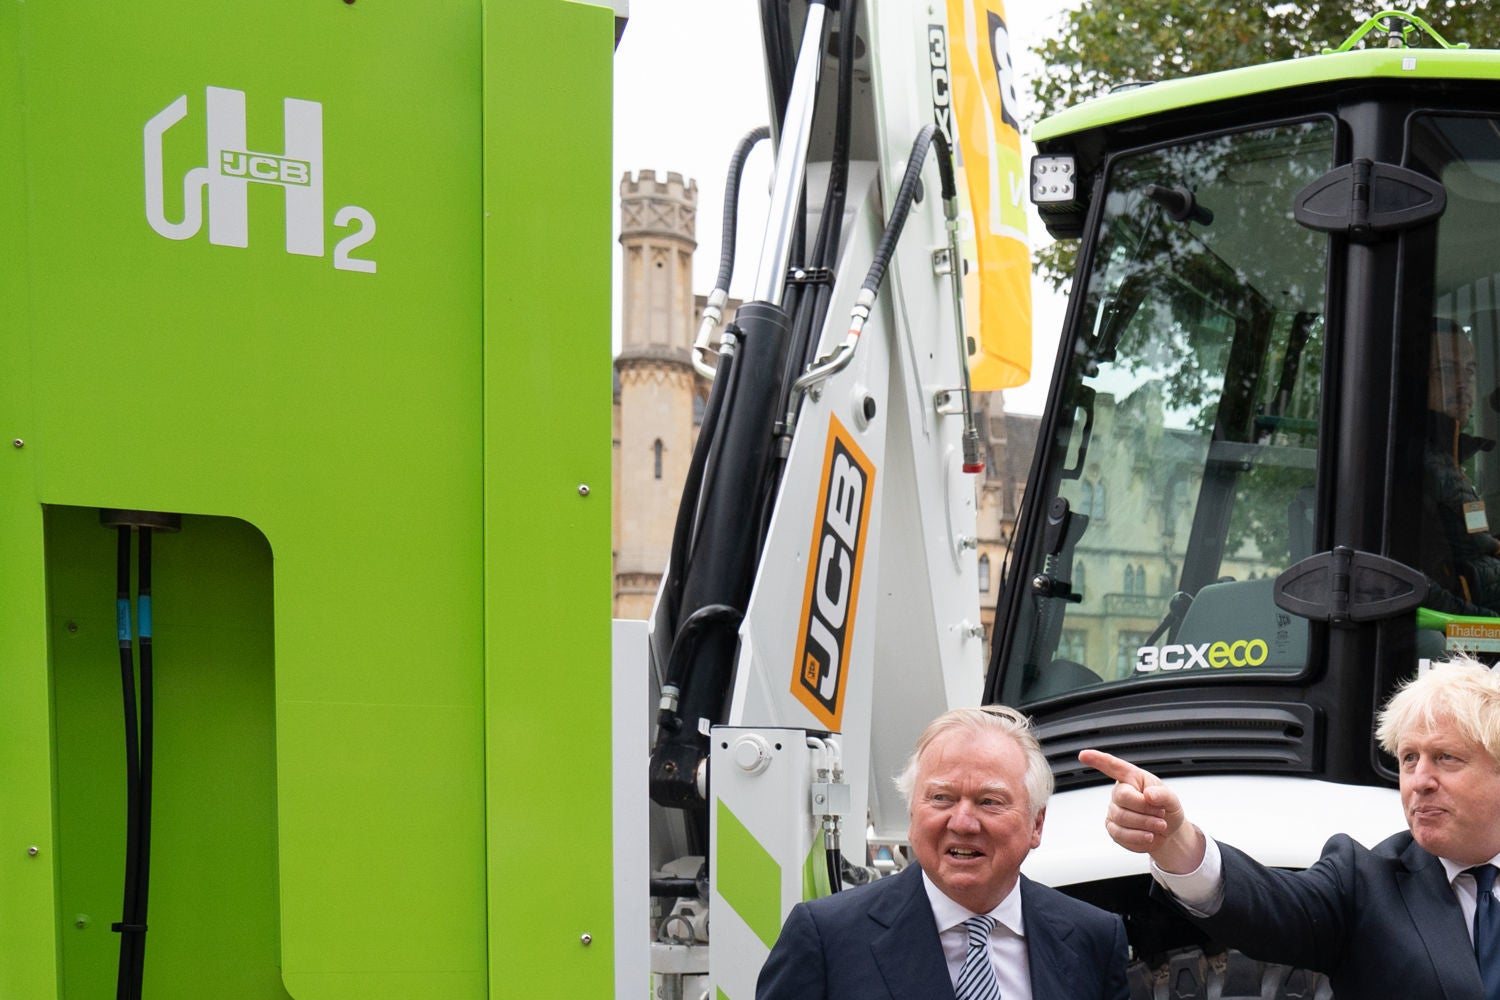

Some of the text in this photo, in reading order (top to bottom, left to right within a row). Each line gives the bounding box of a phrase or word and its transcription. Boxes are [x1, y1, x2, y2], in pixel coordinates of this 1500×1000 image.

[222, 151, 309, 184] JCB
[809, 452, 864, 701] JCB
[1135, 638, 1269, 672] 3CXeco
